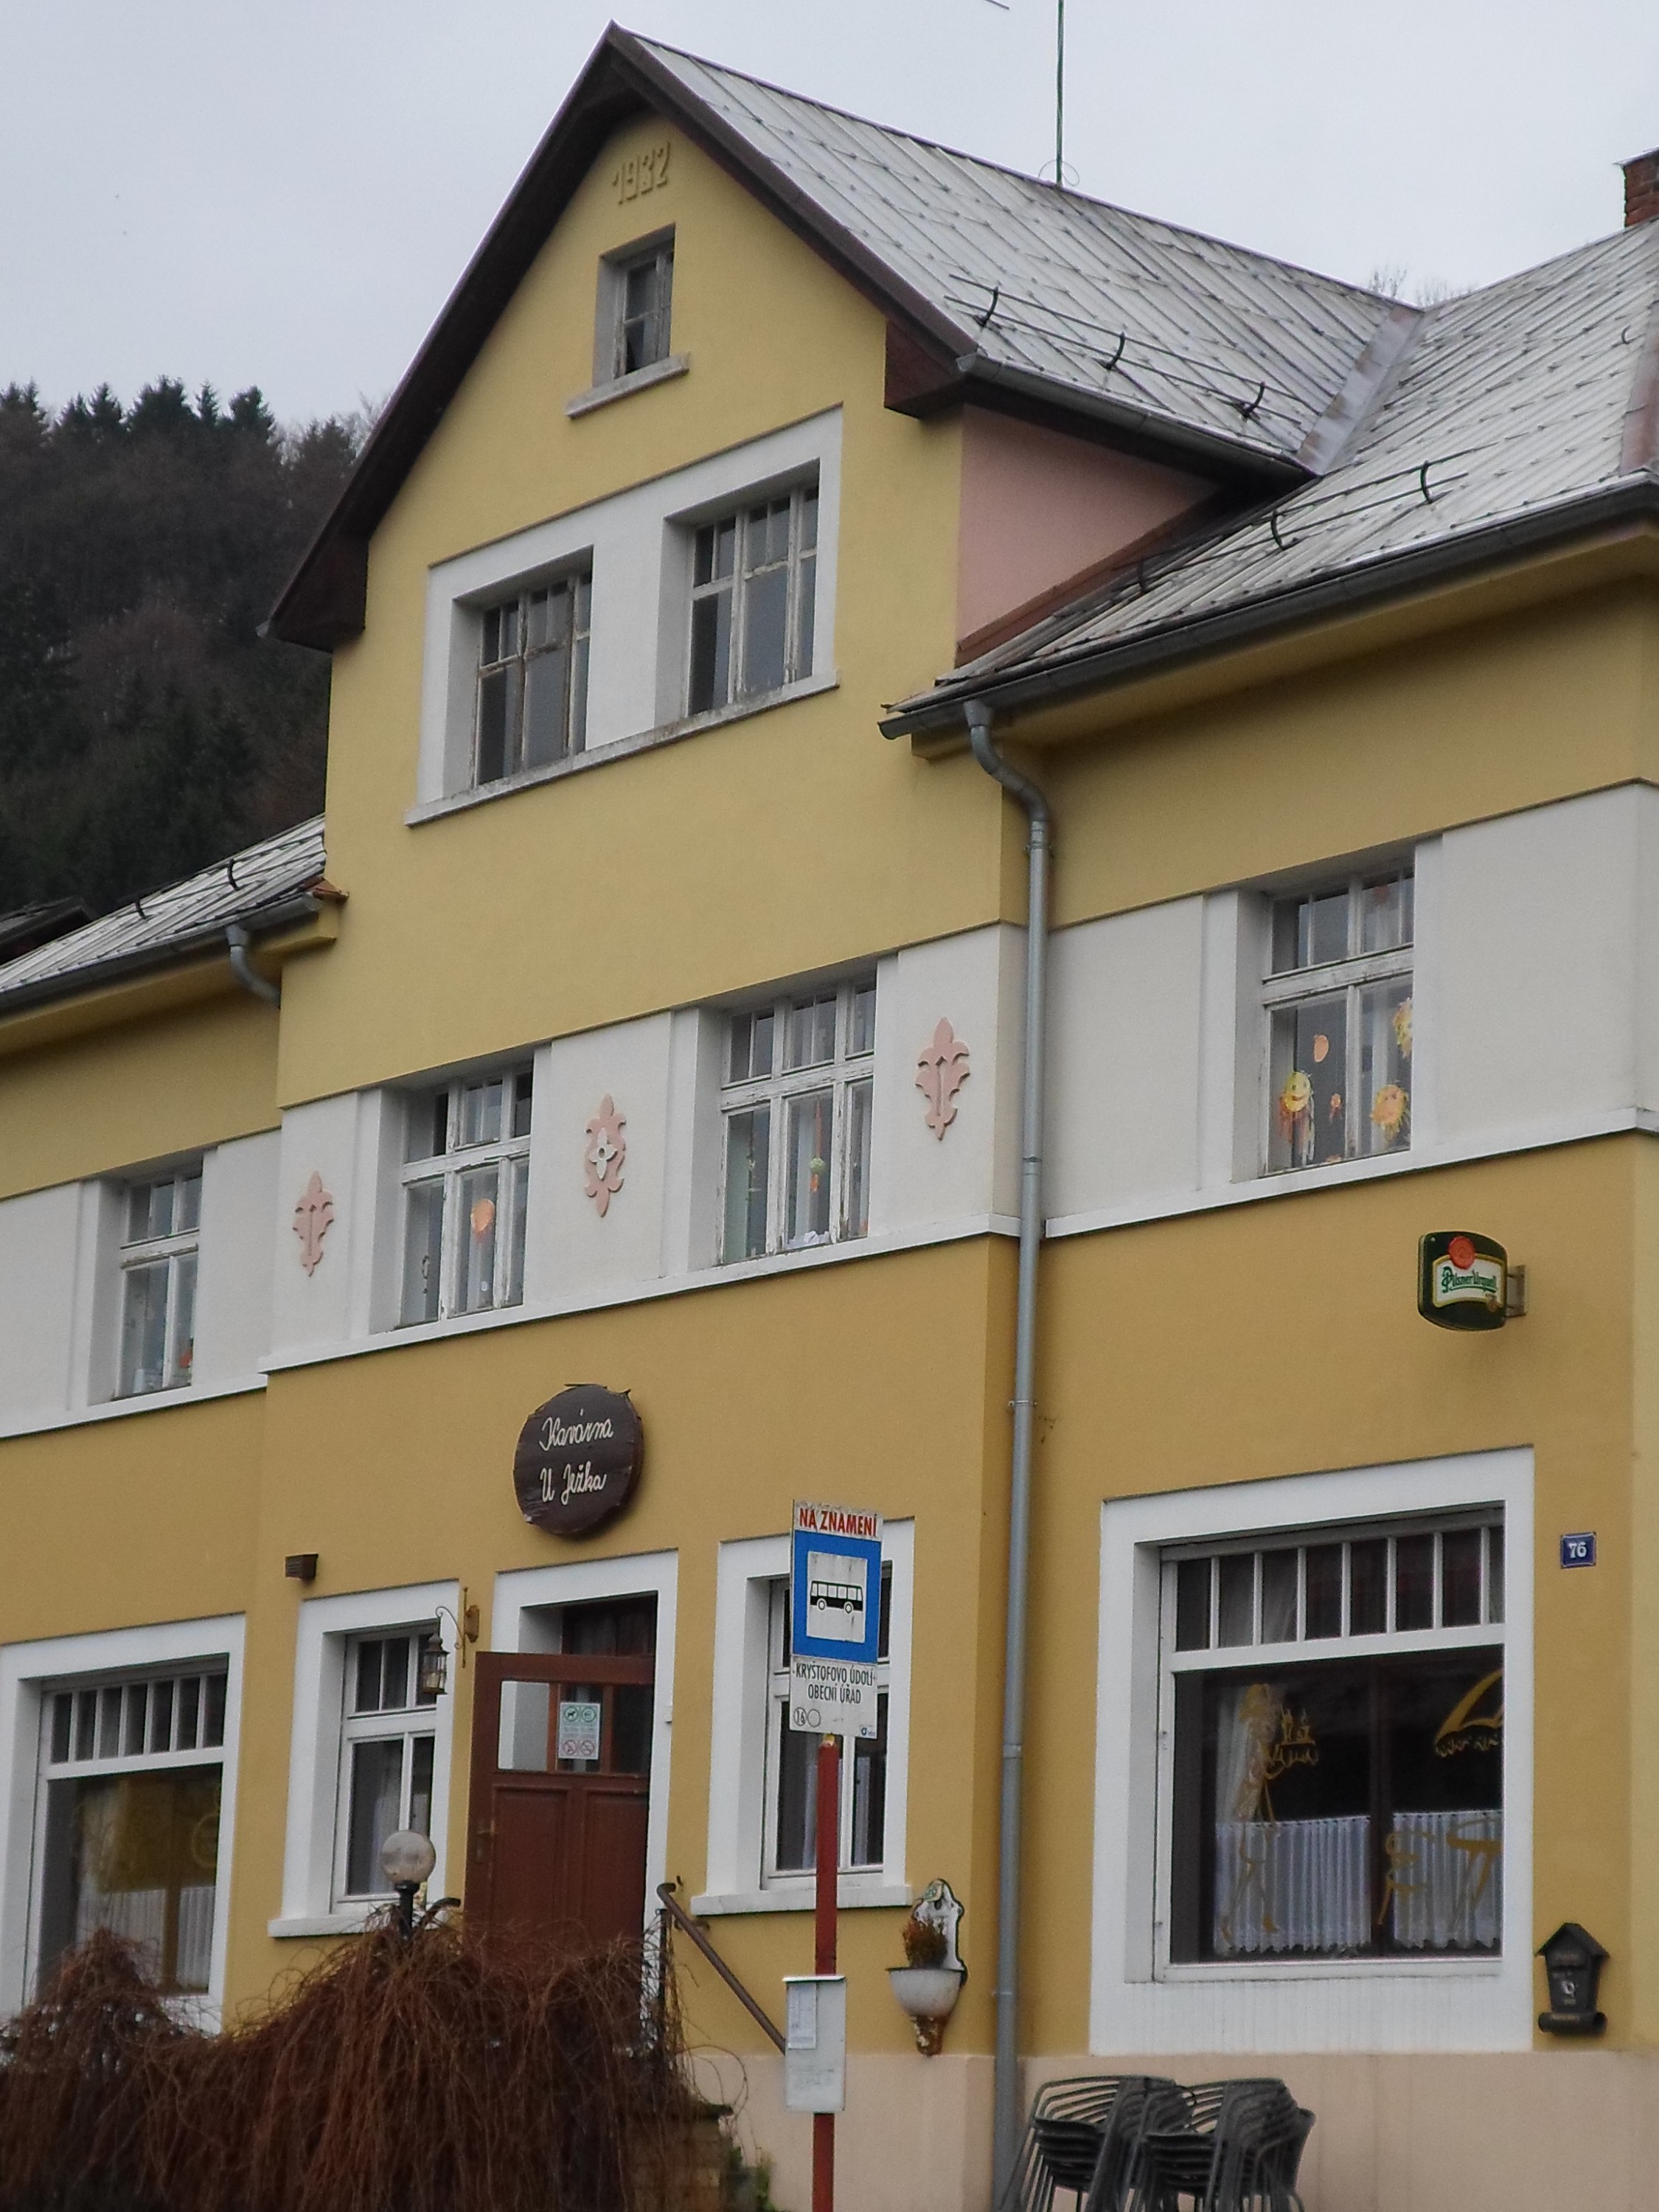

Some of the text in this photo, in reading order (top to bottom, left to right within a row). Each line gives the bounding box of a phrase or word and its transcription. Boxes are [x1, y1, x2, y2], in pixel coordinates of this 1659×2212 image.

[1441, 1266, 1474, 1293] Pilsner
[538, 1408, 614, 1452] Kavárna
[540, 1467, 555, 1503] U
[799, 1508, 877, 1537] NA ZNAMENÍ
[1568, 1542, 1587, 1558] 76
[796, 1660, 874, 1686] KRYŠTOFOVO ÚDOLÍ
[807, 1683, 861, 1704] OBECNÍ ÚŘAD
[796, 1710, 806, 1725] 16
